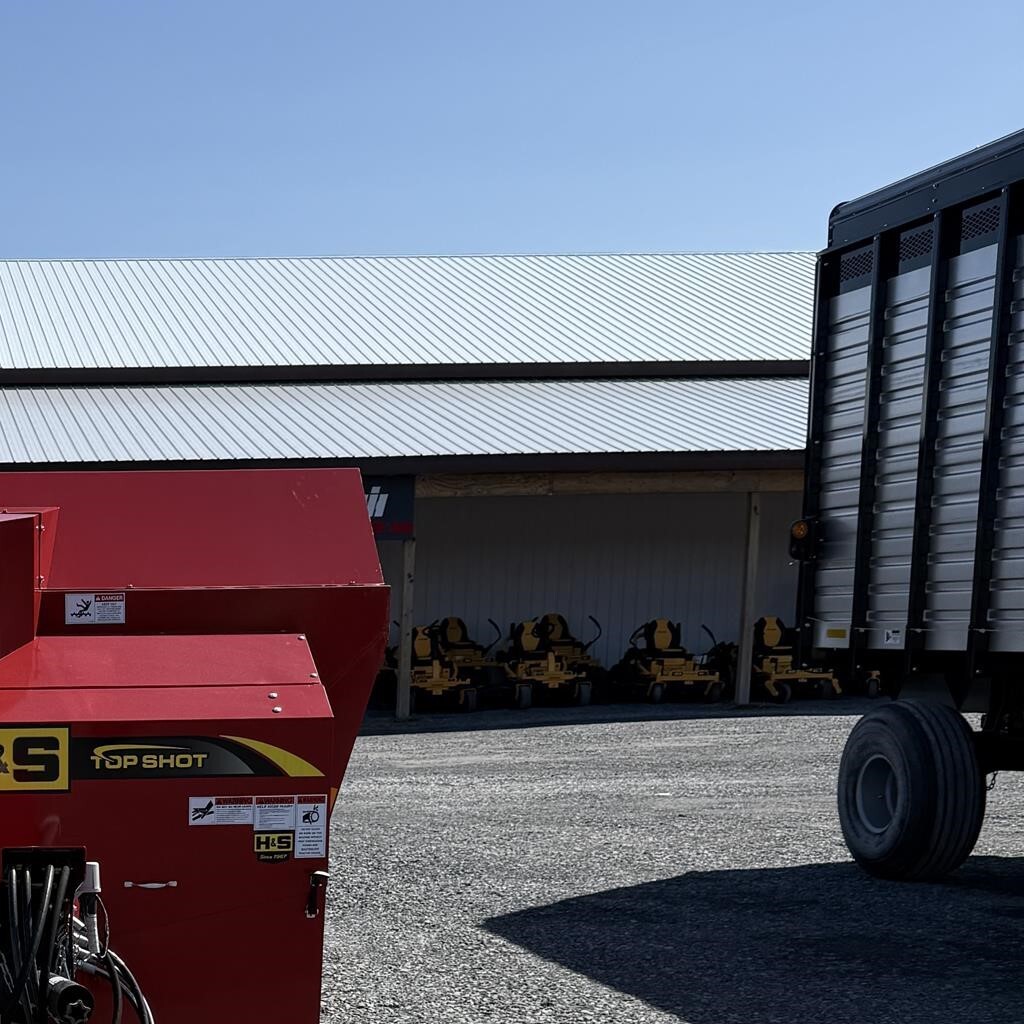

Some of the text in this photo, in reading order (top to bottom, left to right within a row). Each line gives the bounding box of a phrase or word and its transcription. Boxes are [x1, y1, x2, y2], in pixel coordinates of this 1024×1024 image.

[90, 753, 208, 770] TOP SHOT
[256, 835, 291, 850] H&S
